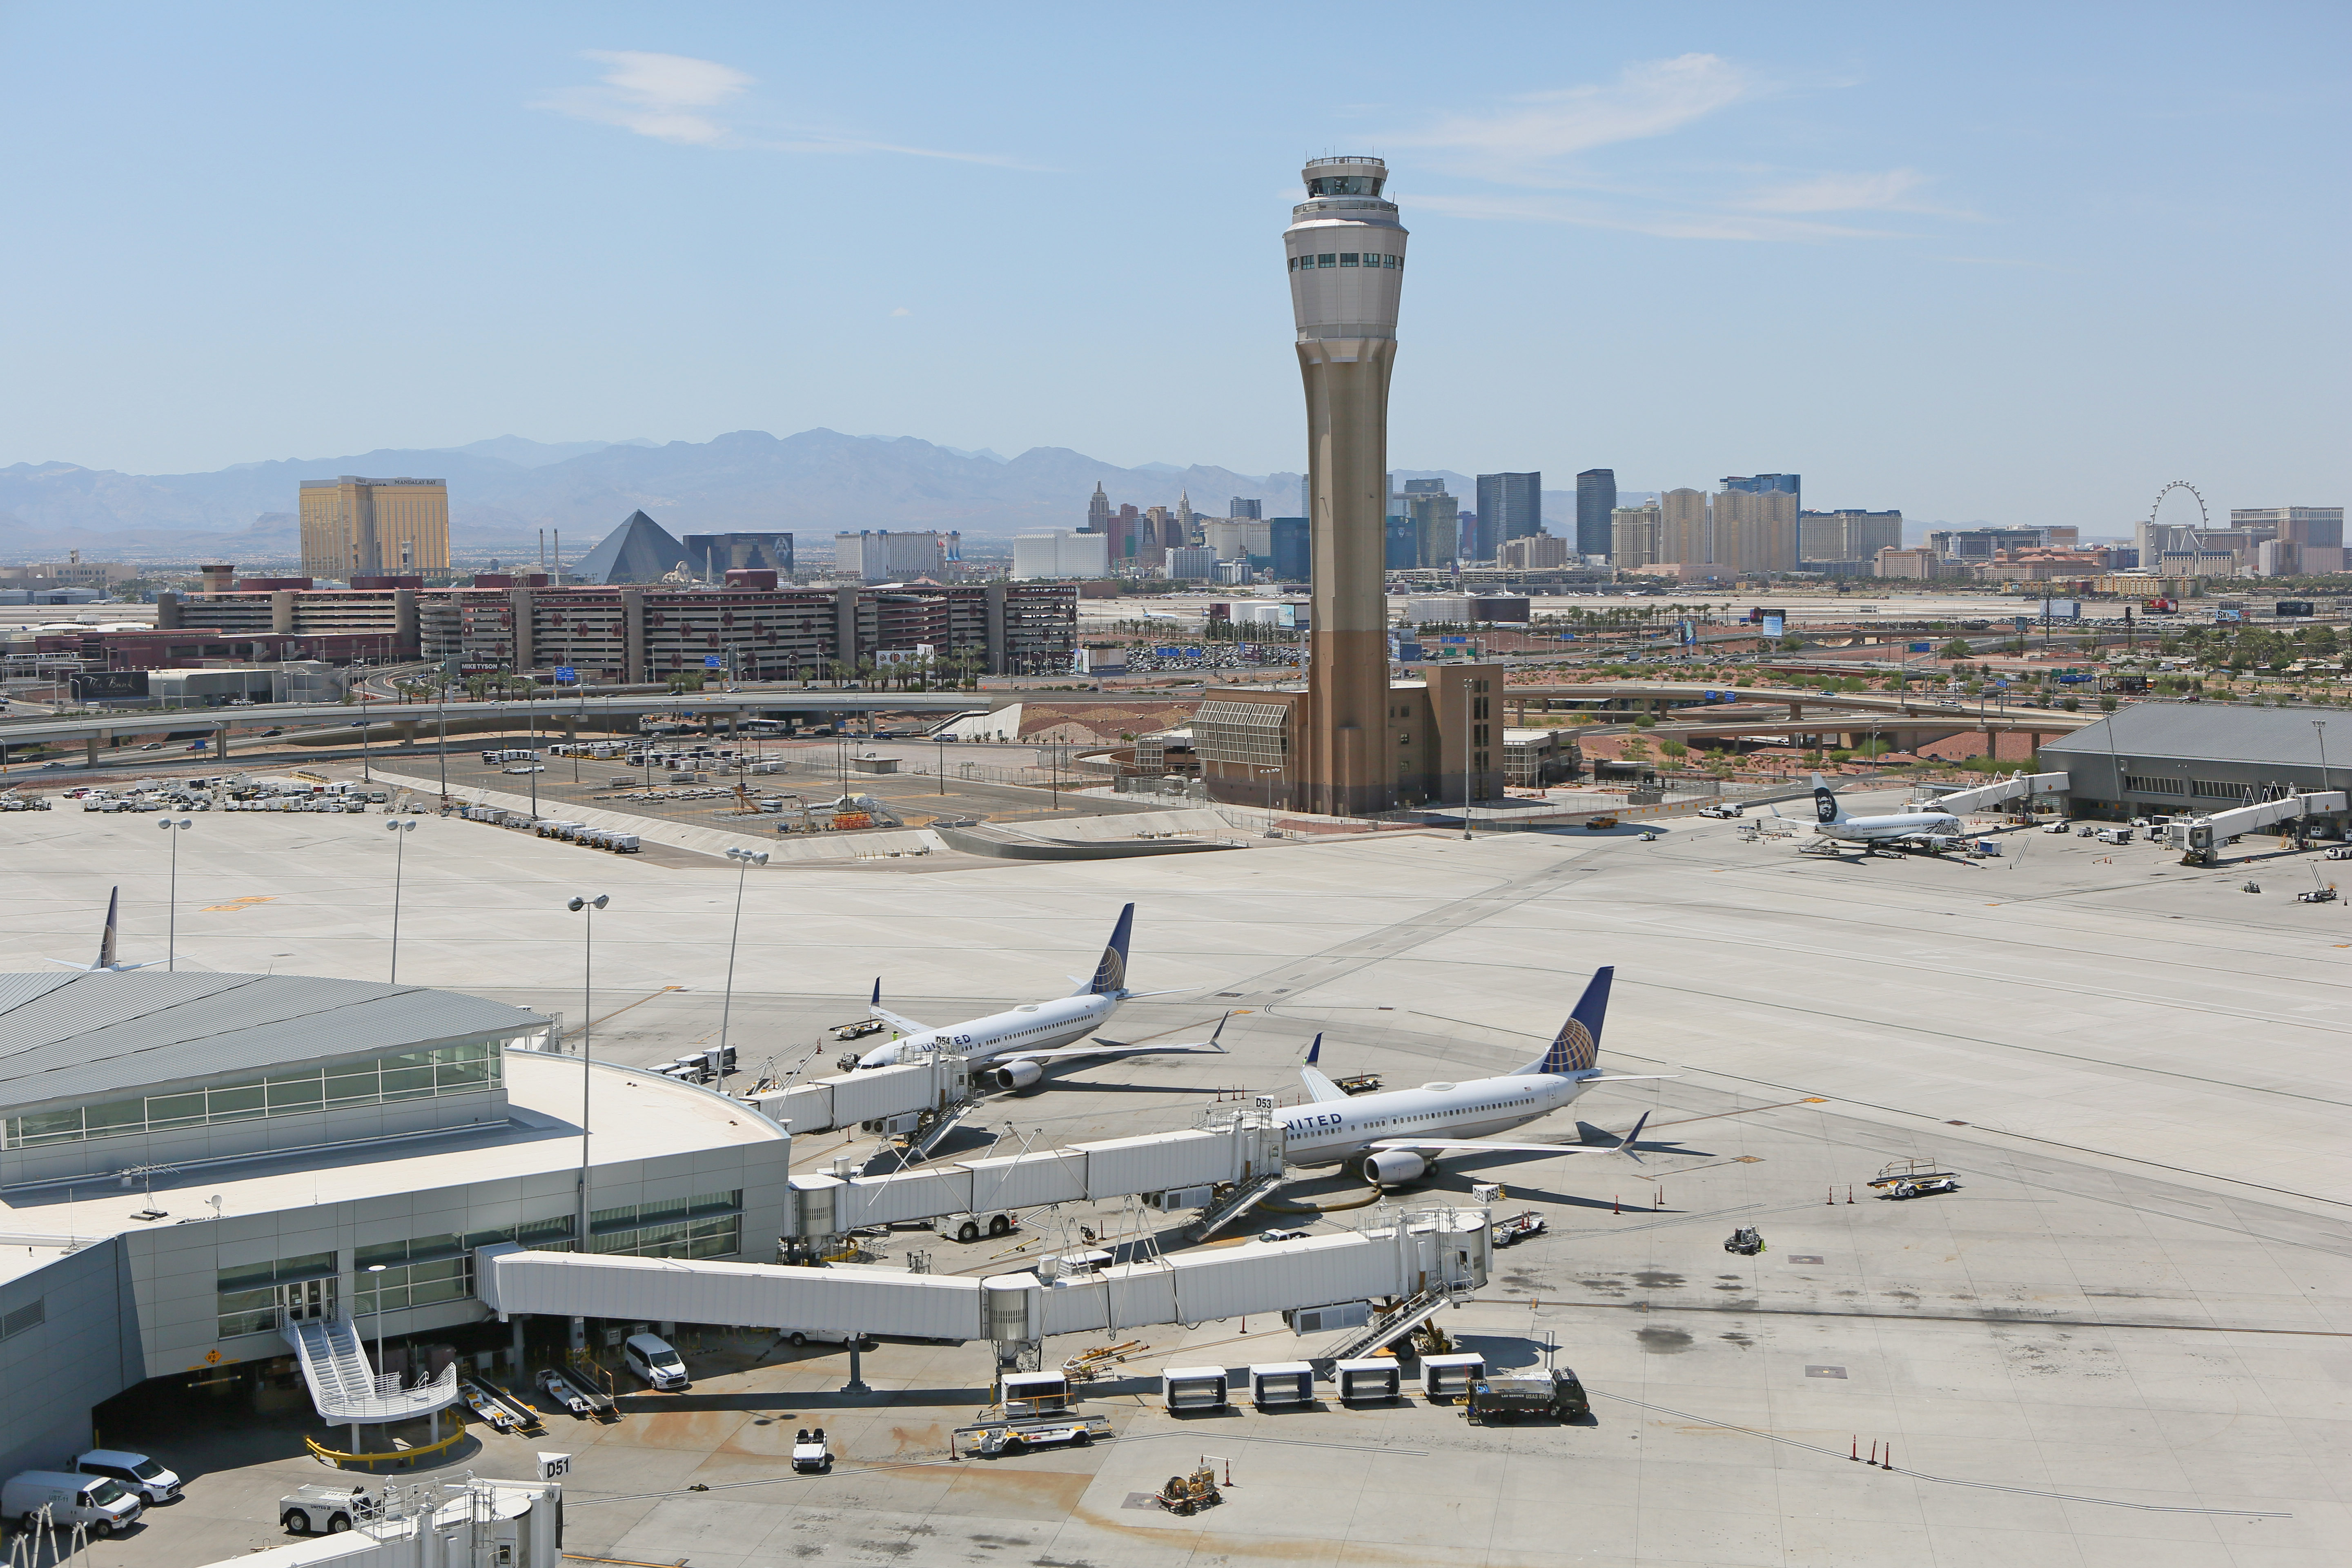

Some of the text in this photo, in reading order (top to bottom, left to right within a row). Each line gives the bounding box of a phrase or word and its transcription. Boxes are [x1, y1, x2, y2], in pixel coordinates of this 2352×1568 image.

[2218, 610, 2230, 619] SKY
[82, 674, 137, 690] The Bank
[1925, 818, 1959, 835] Alaska
[922, 1034, 971, 1052] UED
[936, 1036, 950, 1045] D54
[1256, 1098, 1272, 1109] D53
[1287, 1114, 1342, 1131] NITED
[1474, 1188, 1484, 1202] D52
[1486, 1188, 1498, 1202] D52
[547, 1458, 568, 1479] D51
